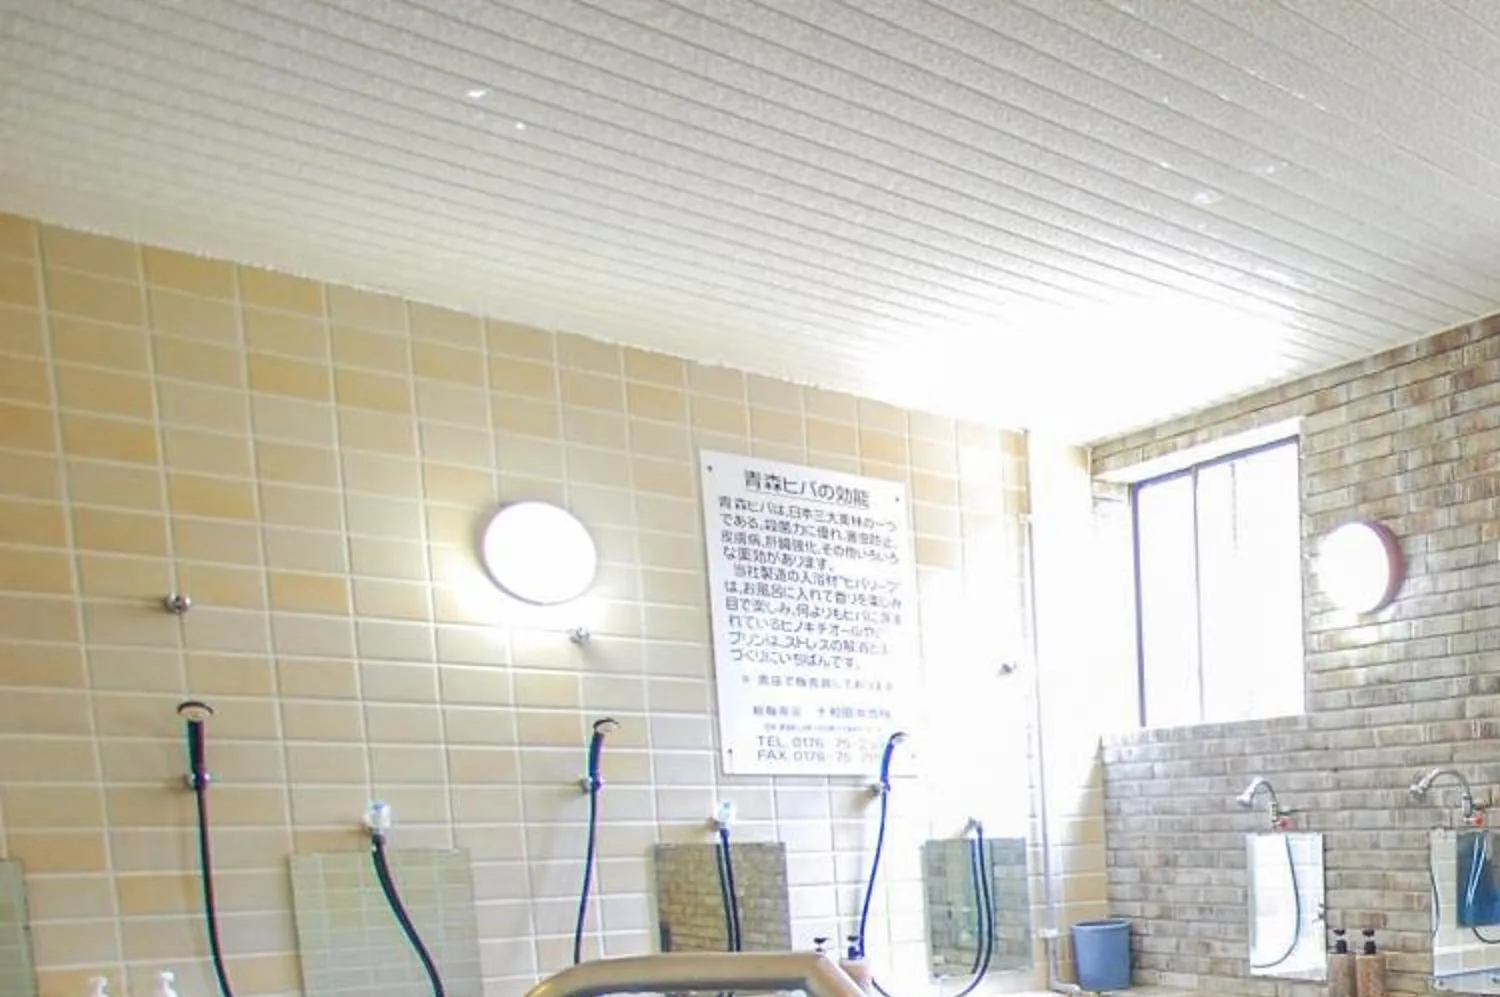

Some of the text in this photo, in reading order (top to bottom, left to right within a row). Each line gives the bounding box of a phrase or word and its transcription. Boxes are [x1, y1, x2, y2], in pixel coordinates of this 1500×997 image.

[744, 470, 870, 508] 青森ヒバの効能
[757, 735, 784, 748] TEL
[757, 750, 786, 762] FAX
